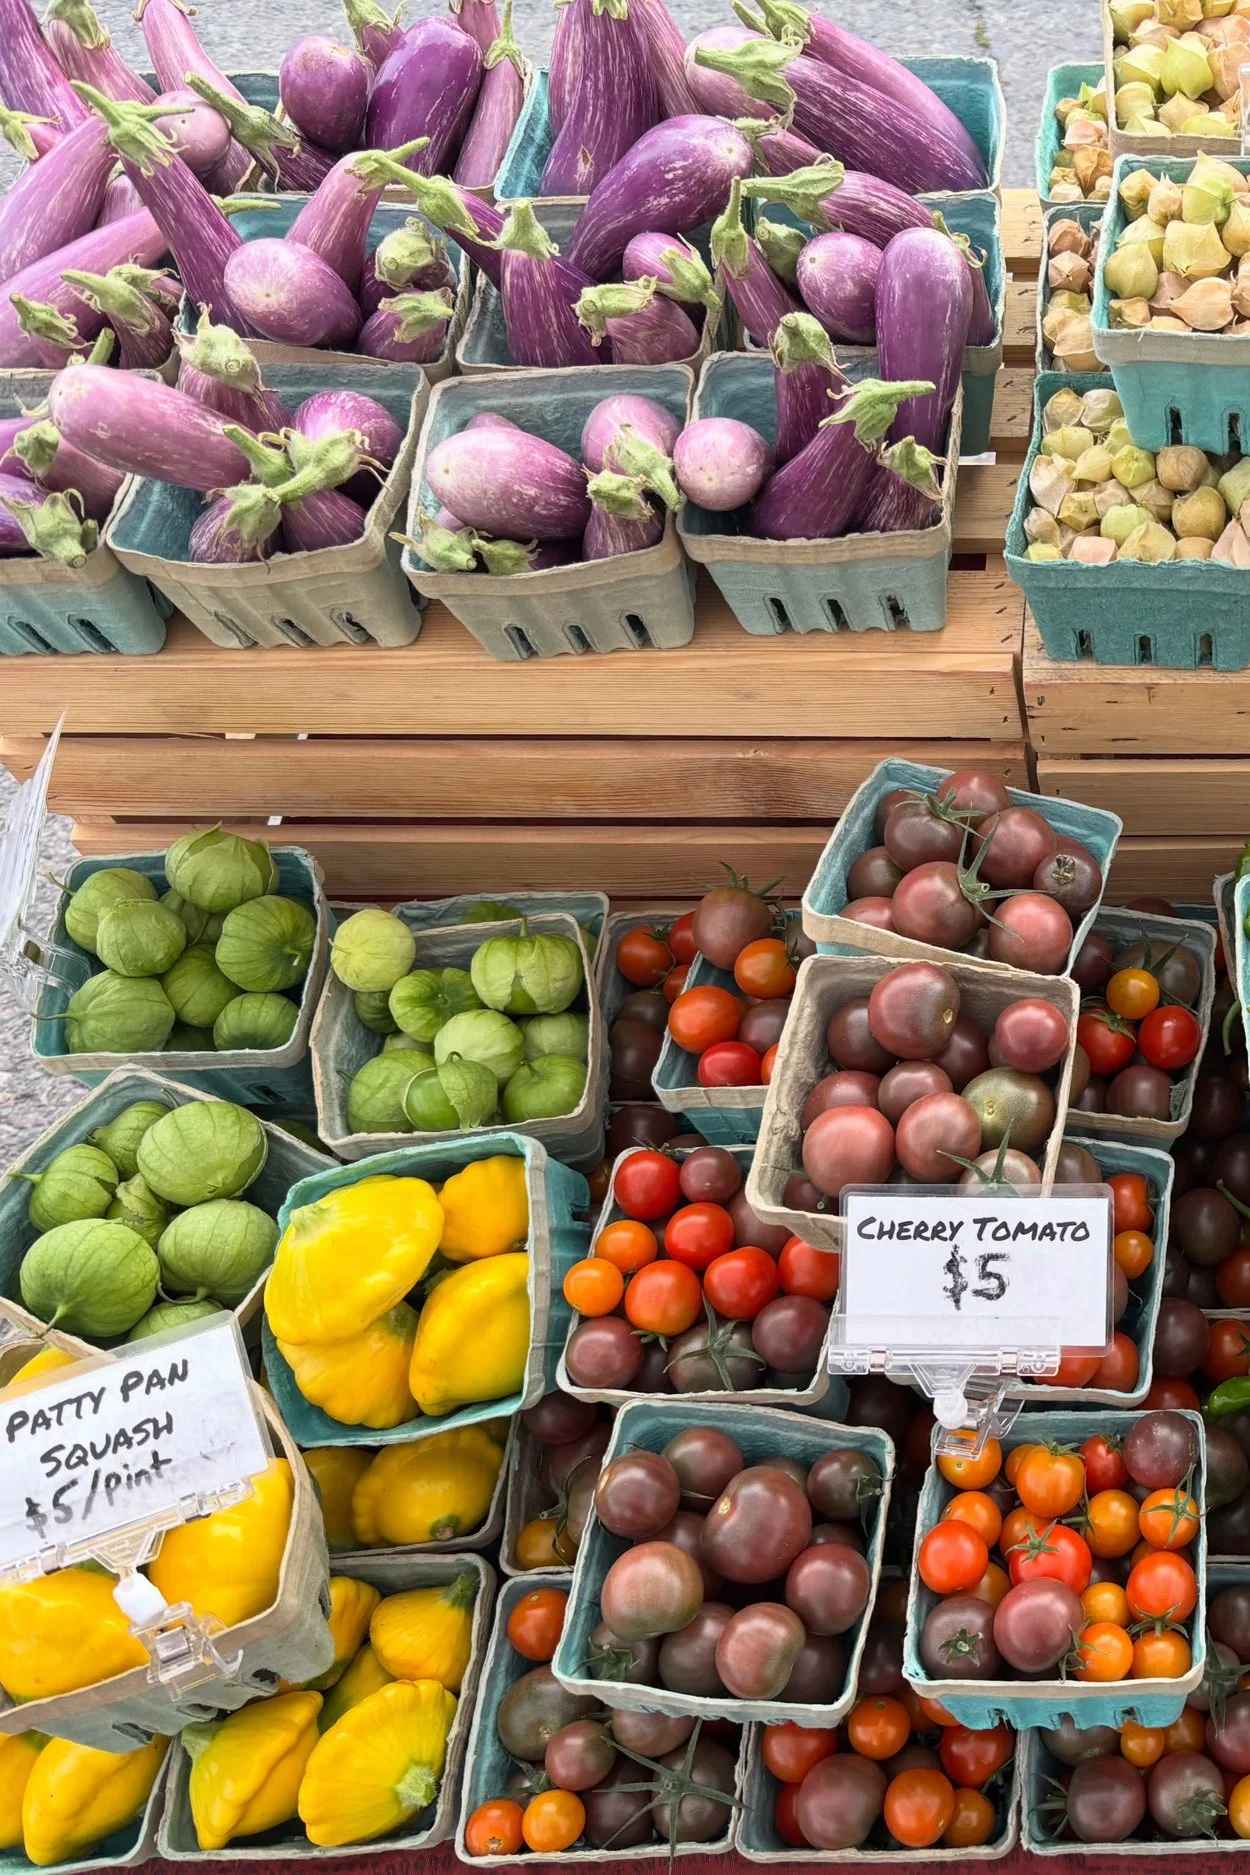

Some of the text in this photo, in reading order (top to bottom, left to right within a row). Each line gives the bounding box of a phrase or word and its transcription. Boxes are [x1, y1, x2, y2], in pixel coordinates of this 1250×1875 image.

[942, 1243, 1012, 1311] $5
[6, 1358, 189, 1443] PATTY PAN
[39, 1411, 174, 1478] SQUASH
[25, 1450, 172, 1539] $5/pint
